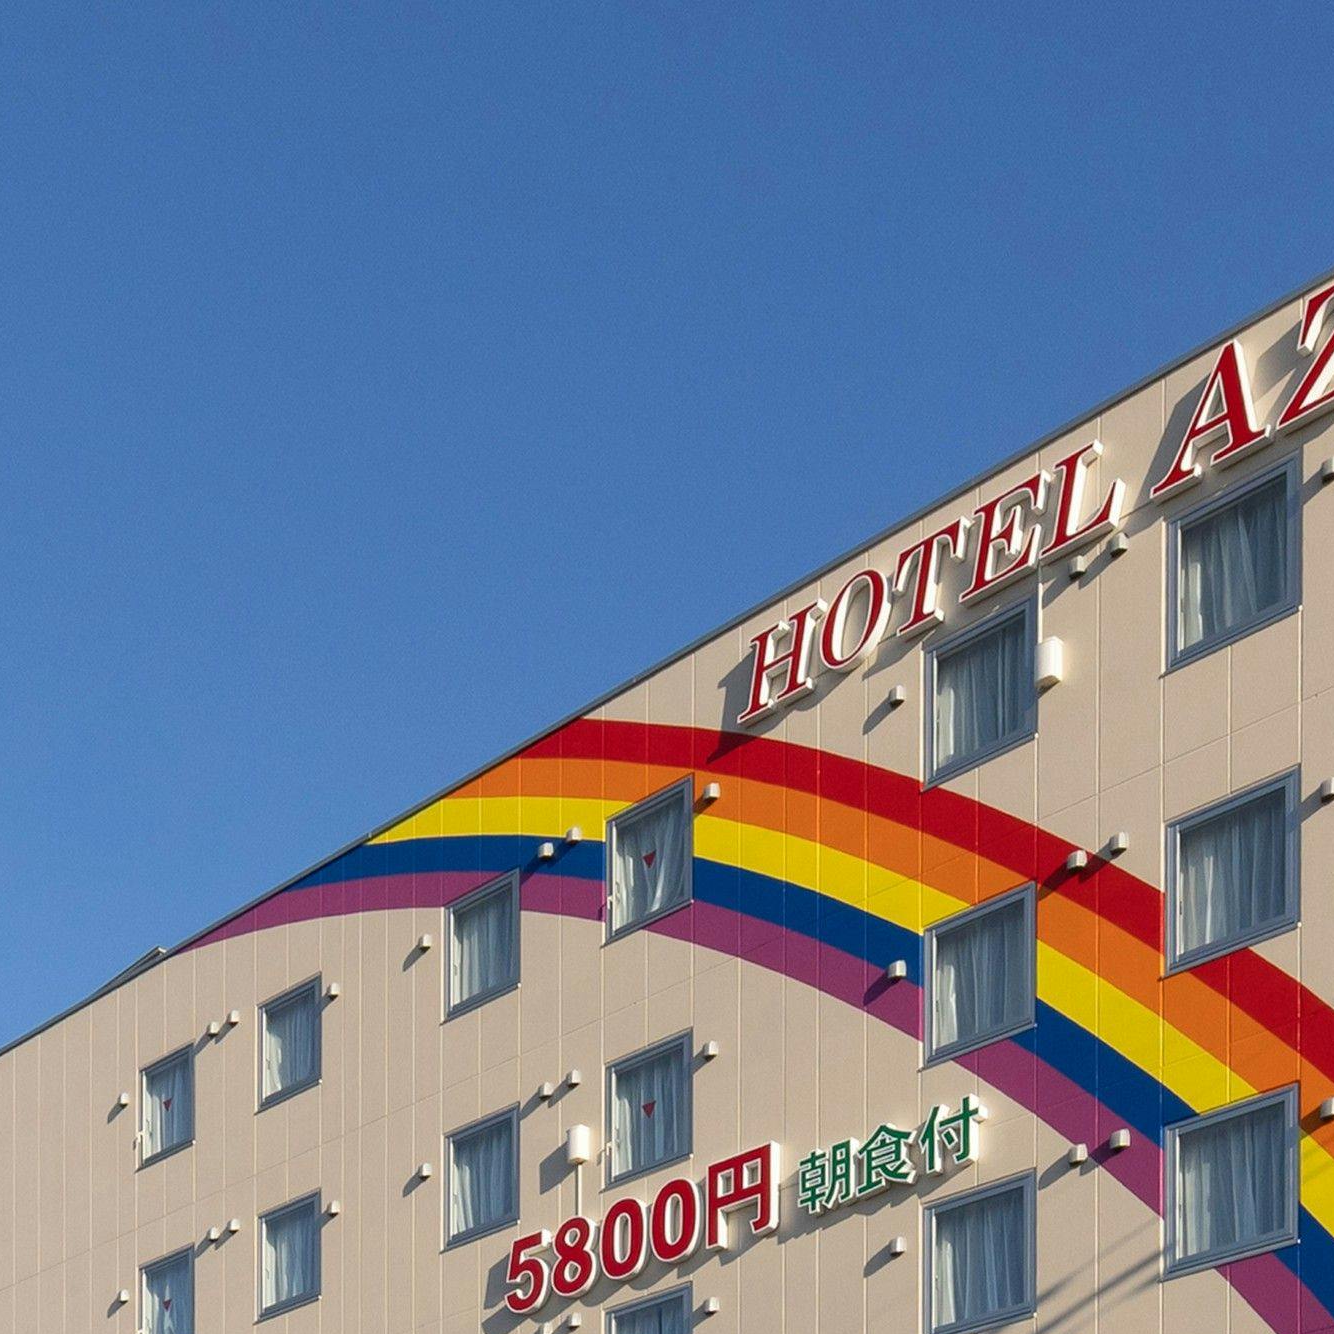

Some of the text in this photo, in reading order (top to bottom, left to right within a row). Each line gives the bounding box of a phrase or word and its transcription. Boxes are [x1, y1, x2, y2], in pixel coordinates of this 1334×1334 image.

[736, 438, 1125, 726] HOTEL
[503, 1093, 987, 1314] 5800円 朝食付
